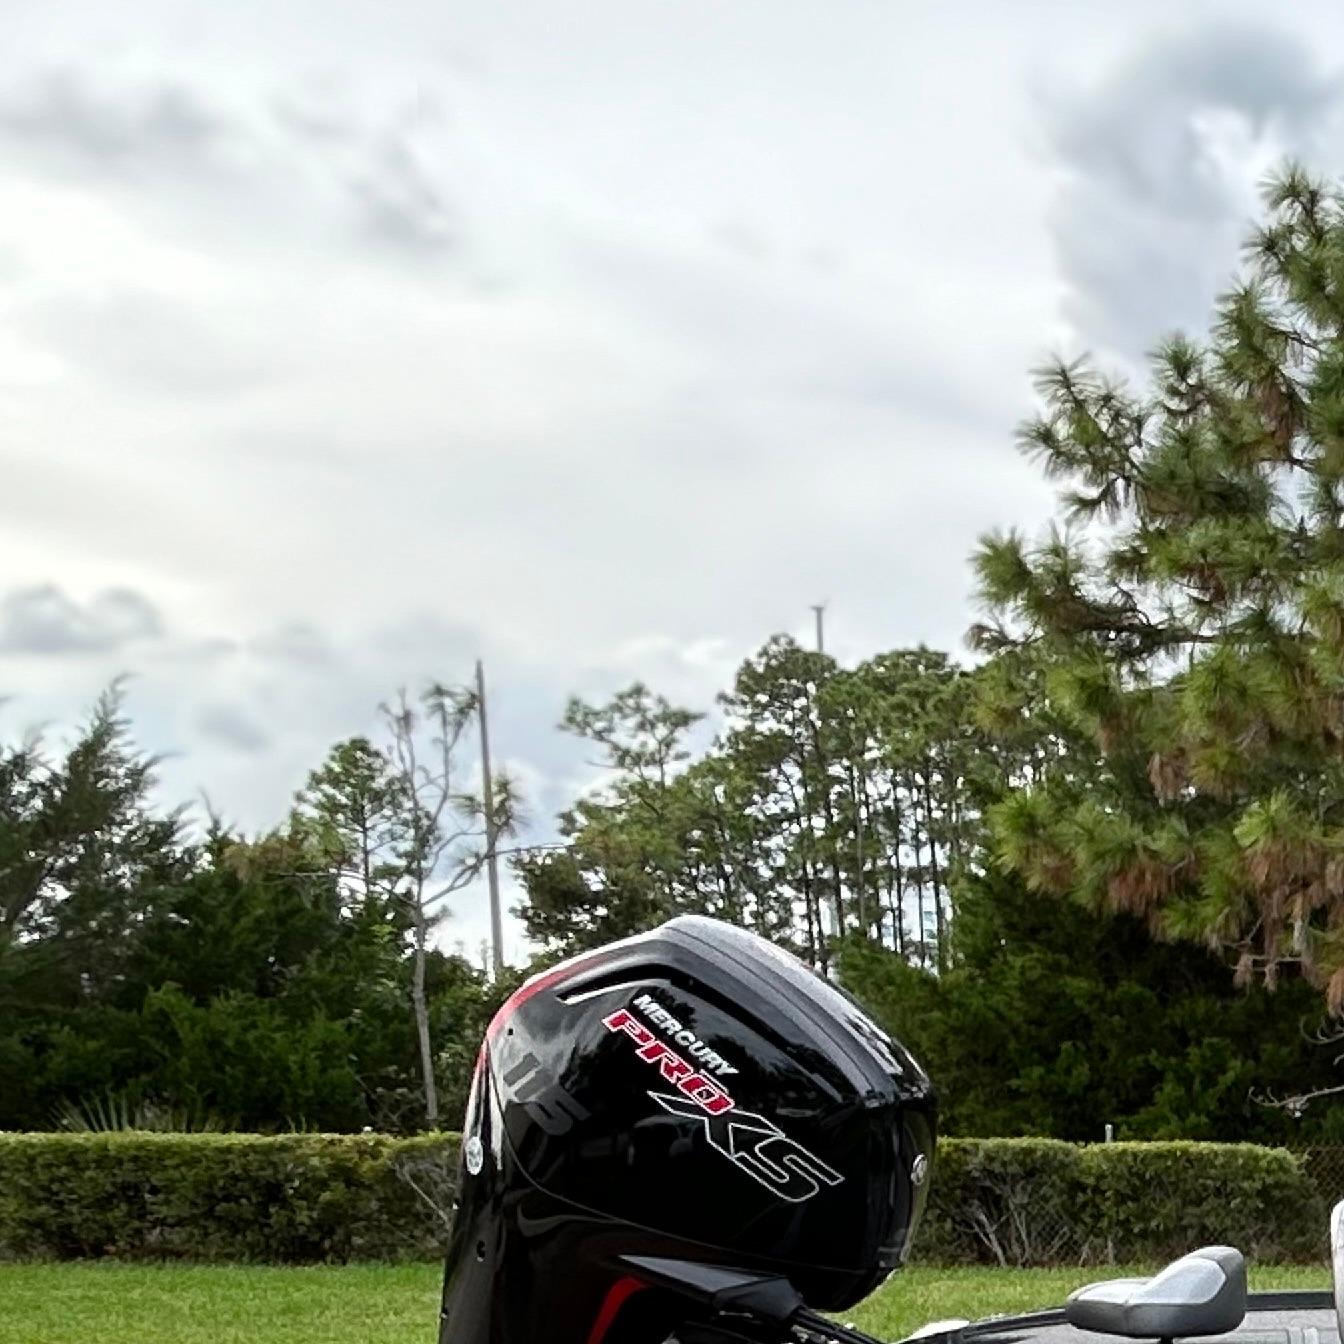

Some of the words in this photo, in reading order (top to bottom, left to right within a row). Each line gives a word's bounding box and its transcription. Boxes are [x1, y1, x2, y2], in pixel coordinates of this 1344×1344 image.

[601, 1009, 736, 1116] PRO
[633, 995, 740, 1076] MERCURY
[647, 1069, 845, 1202] XS
